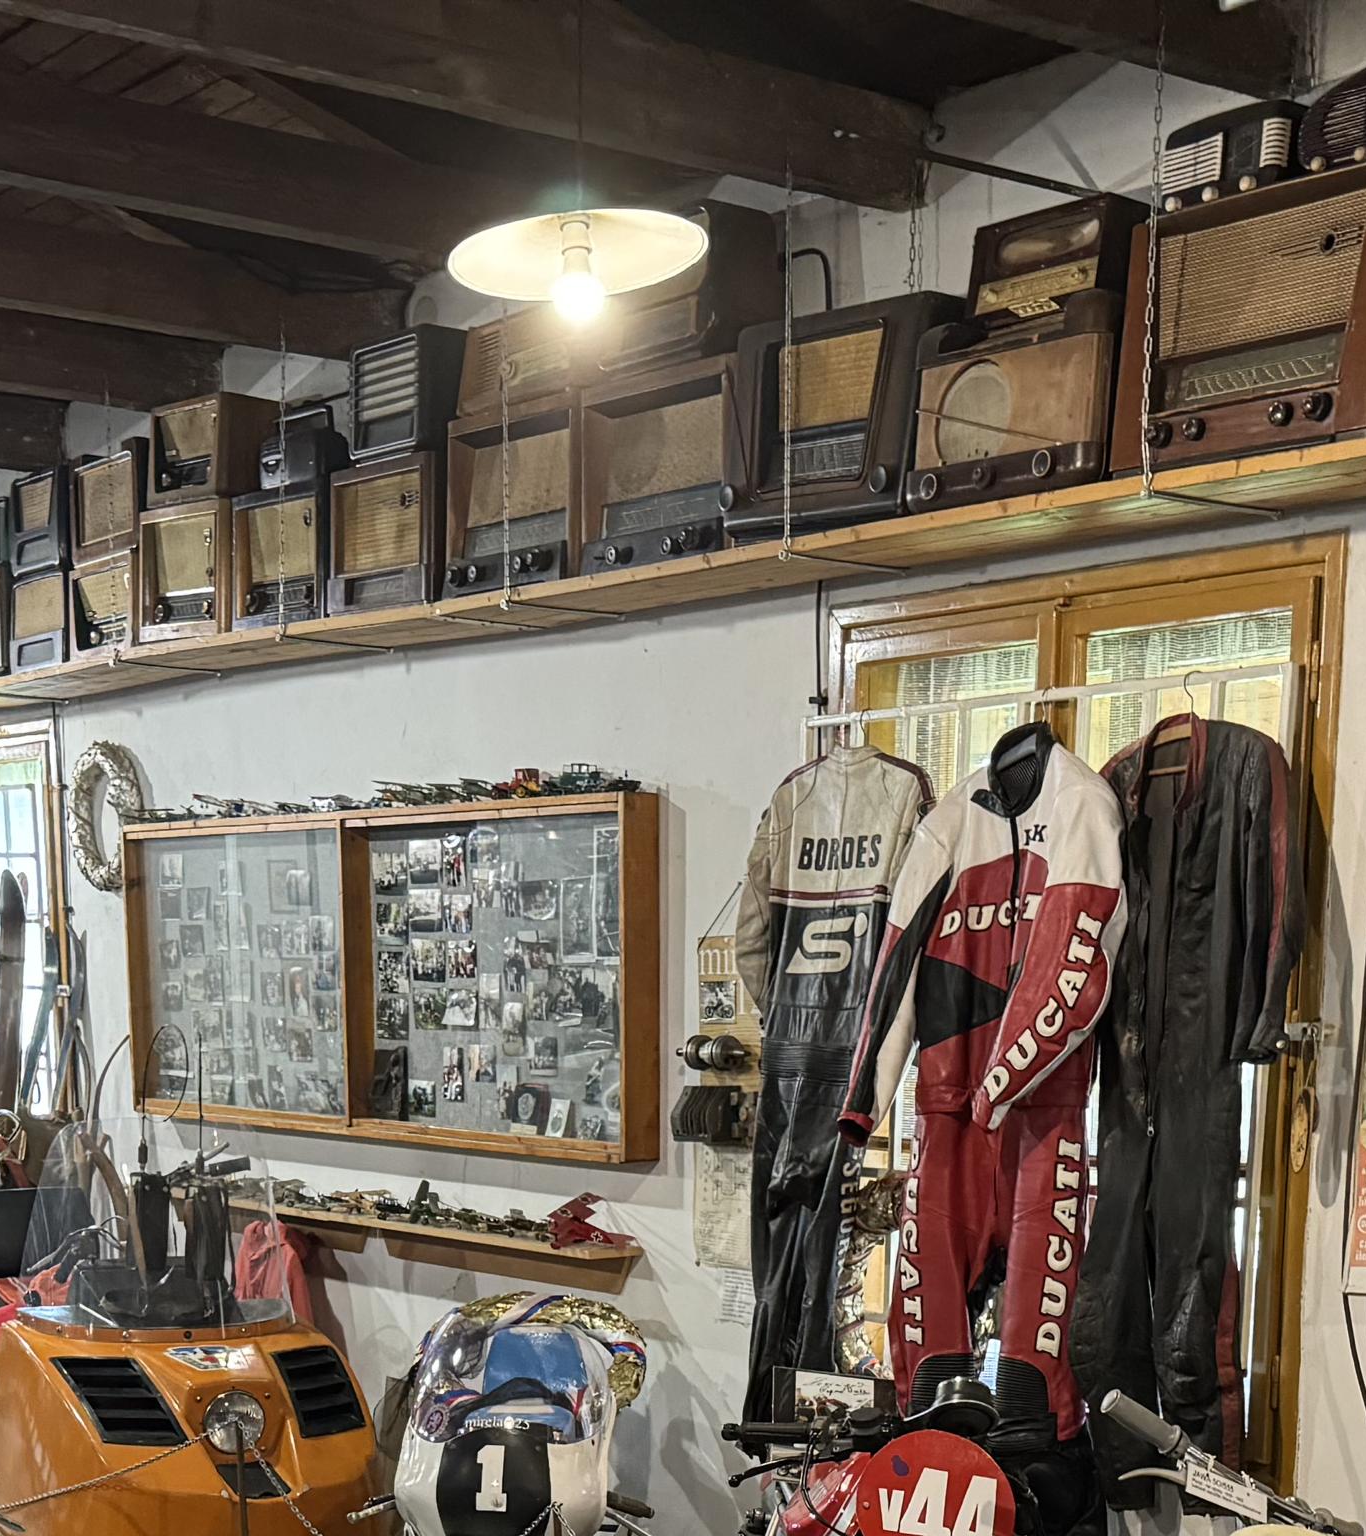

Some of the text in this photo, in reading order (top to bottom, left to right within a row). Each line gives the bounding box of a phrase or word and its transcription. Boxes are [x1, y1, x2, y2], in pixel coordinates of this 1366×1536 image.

[798, 834, 882, 871] BORDES
[984, 910, 1103, 1106] DUCATI
[1036, 1138, 1084, 1358] DUCATI
[475, 1444, 507, 1512] 1
